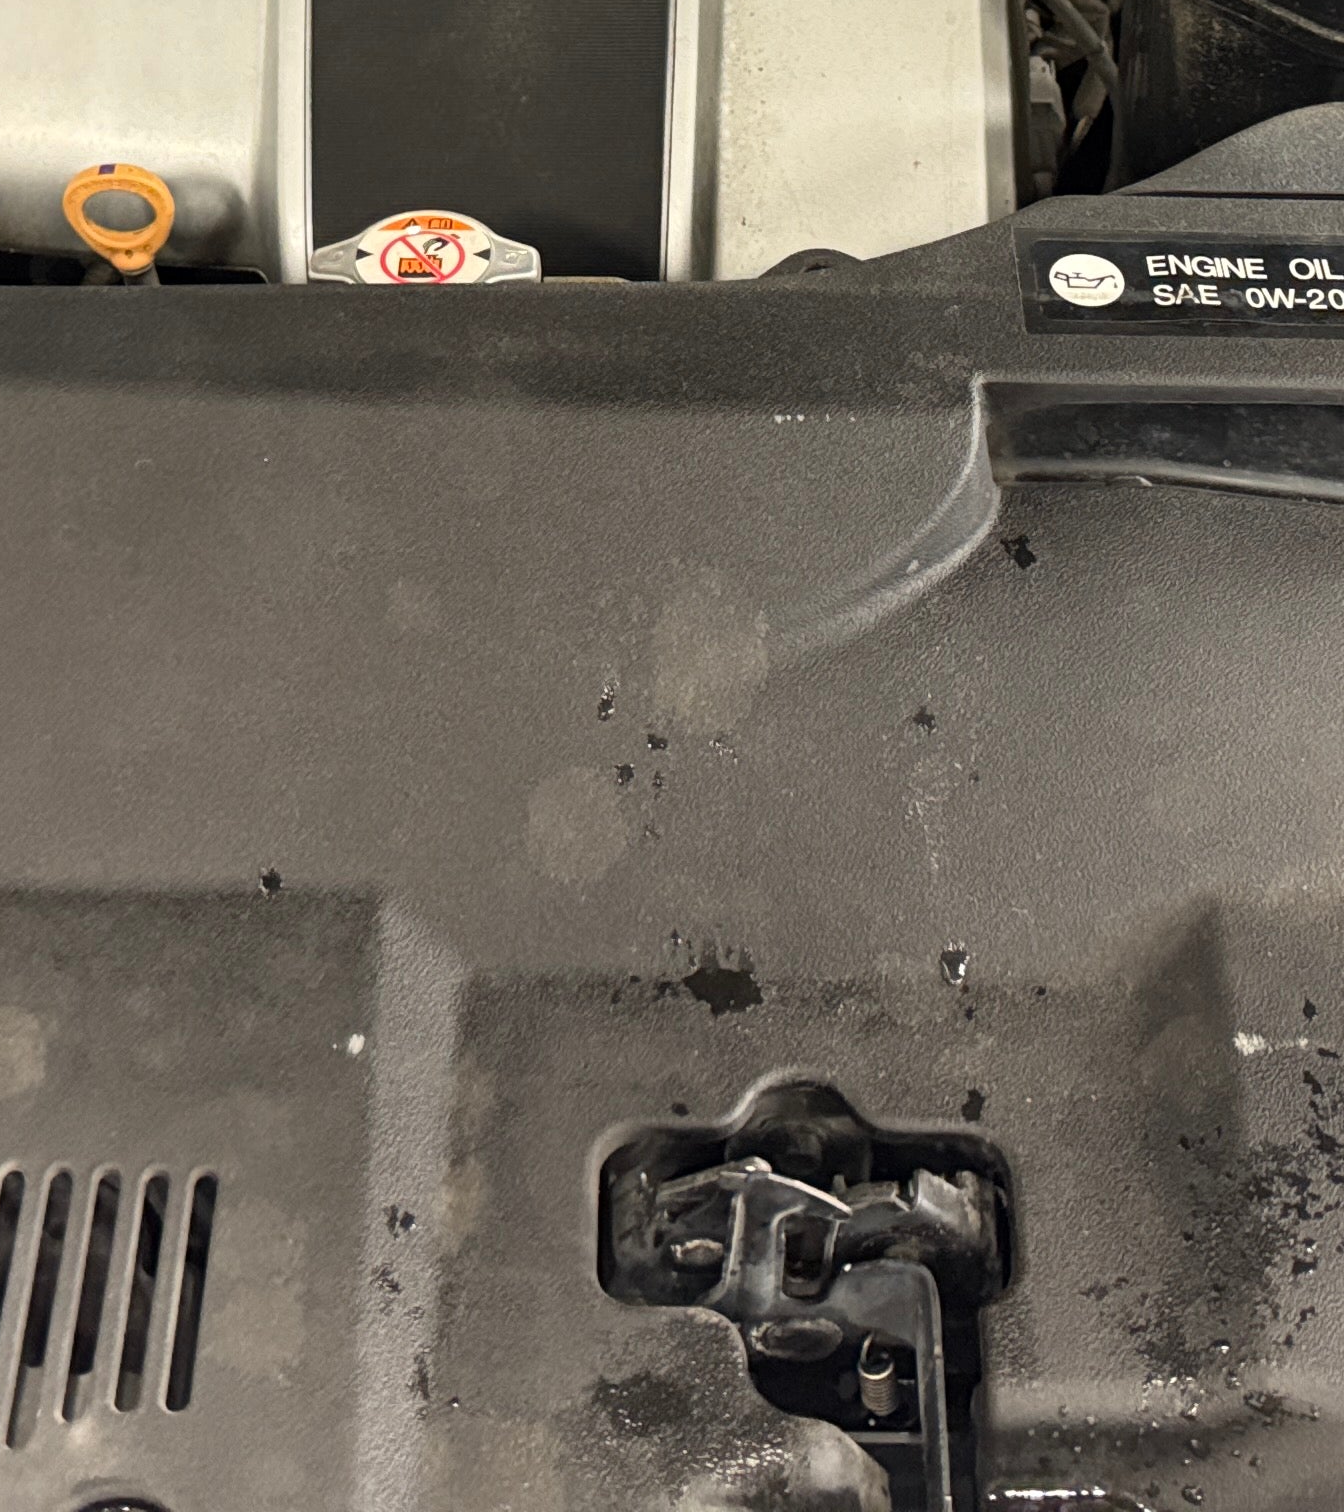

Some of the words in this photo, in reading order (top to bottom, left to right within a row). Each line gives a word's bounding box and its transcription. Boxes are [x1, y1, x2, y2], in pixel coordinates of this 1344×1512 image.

[1145, 254, 1268, 281] ENGINE
[1288, 256, 1344, 281] OIL
[1153, 284, 1222, 307] SAE
